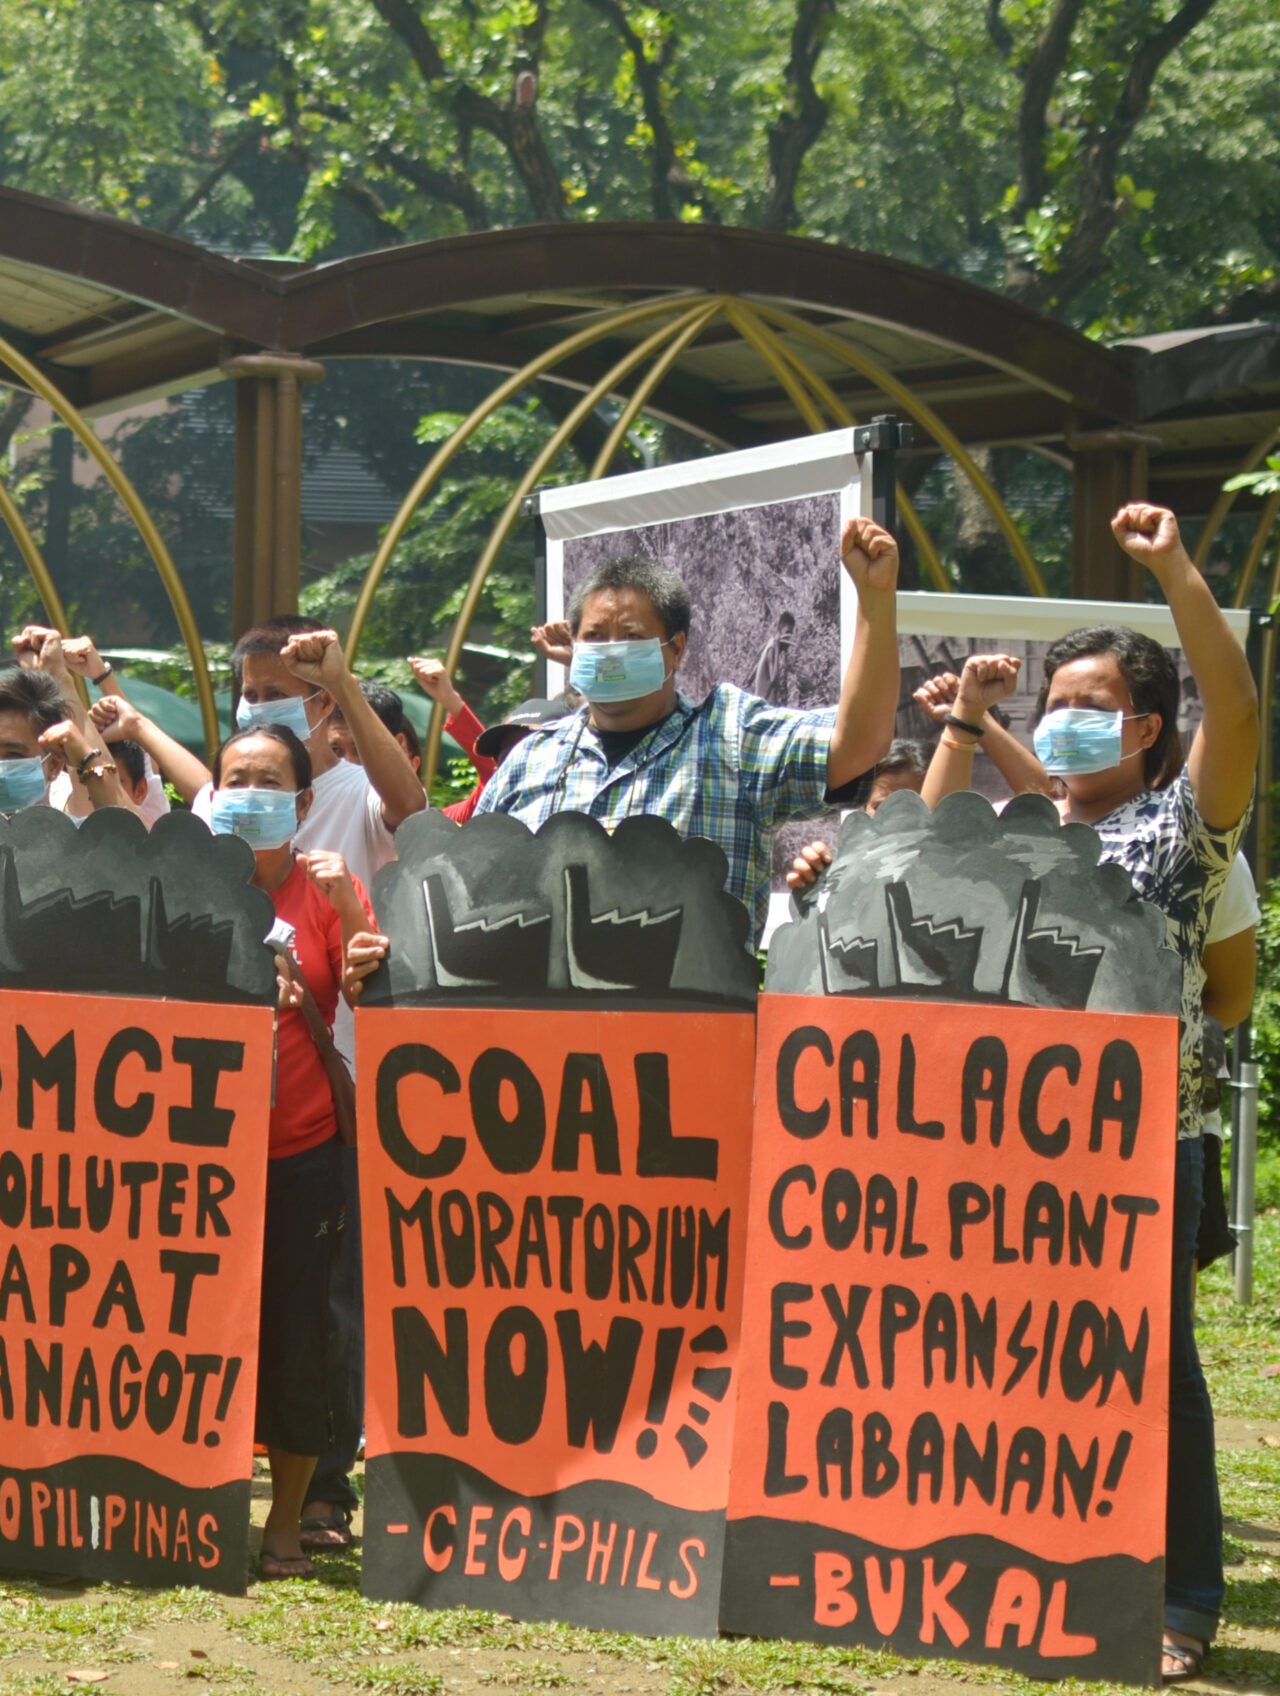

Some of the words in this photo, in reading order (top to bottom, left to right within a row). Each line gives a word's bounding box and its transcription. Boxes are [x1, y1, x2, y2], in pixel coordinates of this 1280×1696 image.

[375, 1042, 719, 1182] COAL
[775, 1025, 1142, 1161] CALACA
[384, 1186, 731, 1312] MORATORIUM
[768, 1163, 929, 1259] COAL
[948, 1180, 1160, 1272] PLANT
[391, 1305, 685, 1460] NOW!
[769, 1281, 1150, 1407] EXPANSION
[763, 1401, 1133, 1522] LABANAN!
